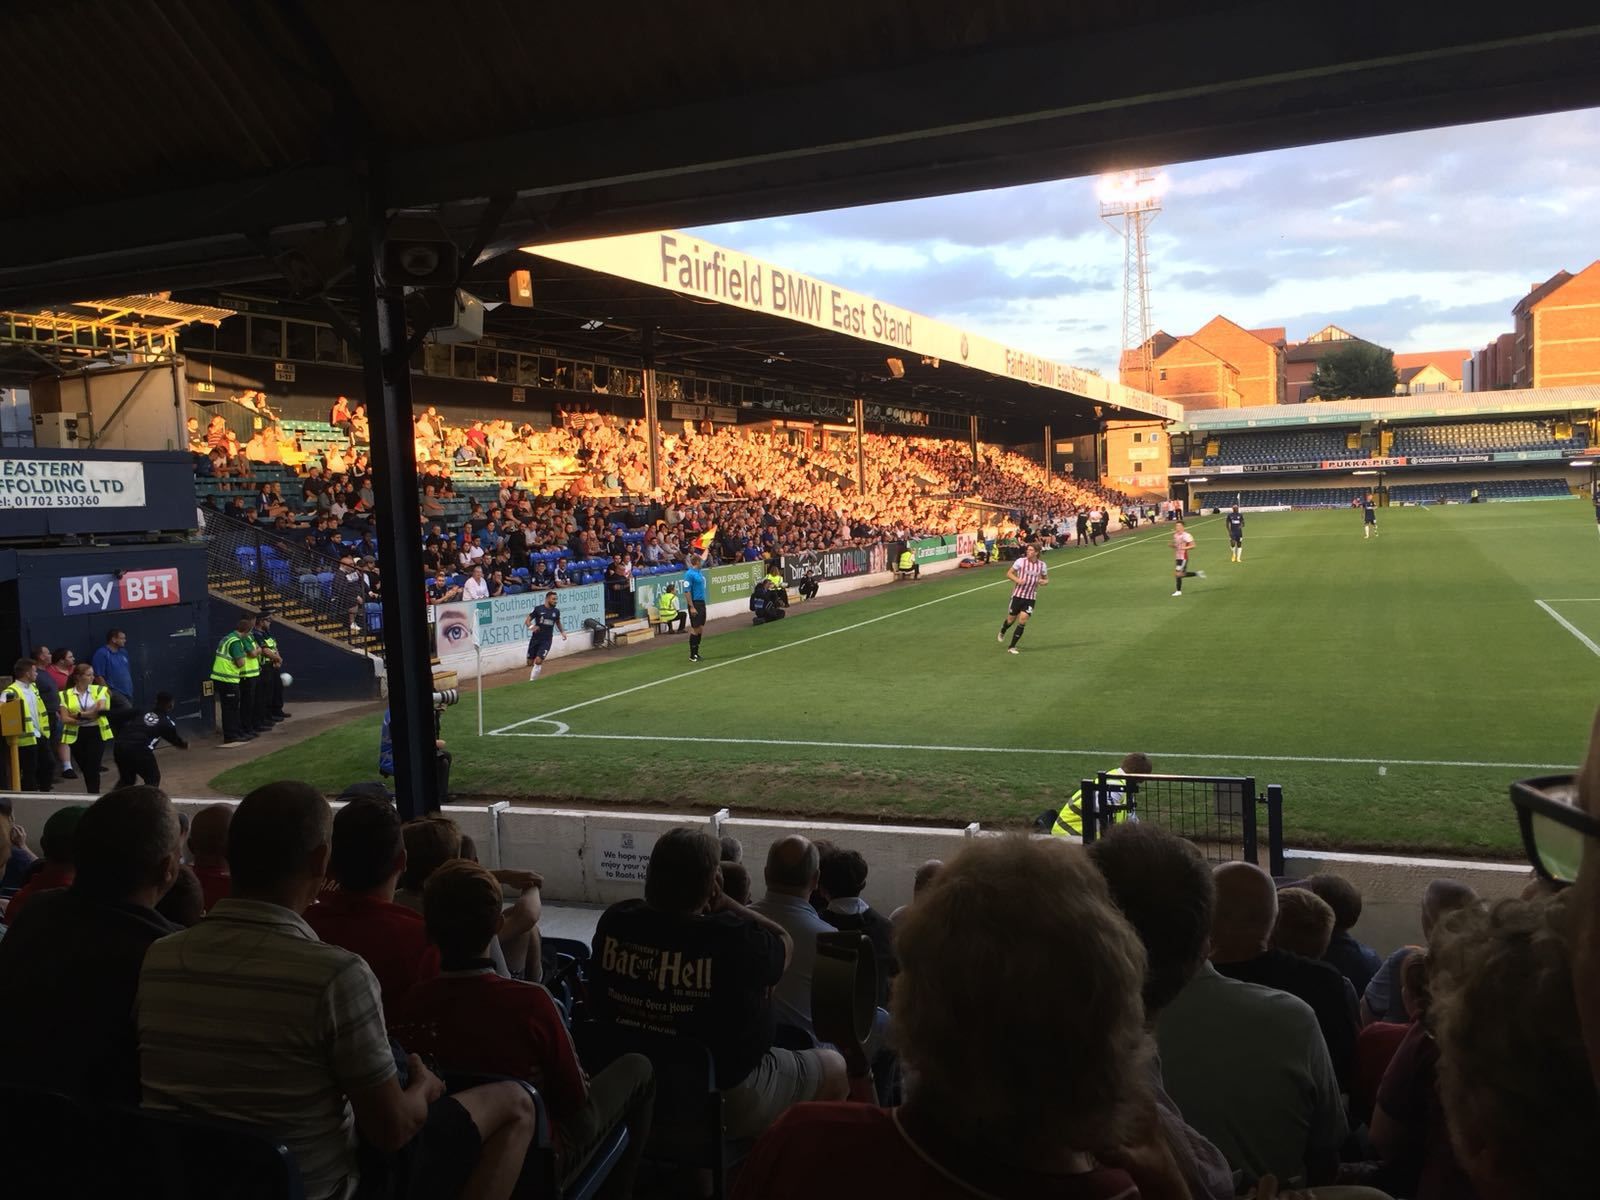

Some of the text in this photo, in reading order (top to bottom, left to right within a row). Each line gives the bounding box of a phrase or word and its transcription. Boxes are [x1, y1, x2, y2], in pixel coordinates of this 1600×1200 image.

[661, 234, 912, 347] Fairfield BMW East Stand
[1418, 456, 1458, 464] Outstanding
[1459, 455, 1489, 463] Branding
[3, 461, 84, 476] EASTERN
[90, 479, 124, 493] LTD
[15, 495, 53, 506] 01702
[57, 495, 100, 507] 530360
[824, 553, 842, 577] HAIR
[842, 550, 867, 575] COLOUR
[711, 575, 727, 584] PROUD
[67, 574, 172, 610] sky BET
[721, 585, 727, 594] OF
[494, 597, 536, 613] Southend
[569, 586, 600, 603] Hospital
[582, 603, 599, 614] 01702
[479, 625, 510, 646] ASER
[604, 851, 616, 859] We
[619, 851, 637, 862] hope
[601, 861, 621, 871] enjoy
[622, 863, 640, 871] your
[606, 870, 614, 878] to
[615, 870, 635, 879] Roots
[601, 935, 640, 980] Bat
[657, 950, 713, 993] Hell
